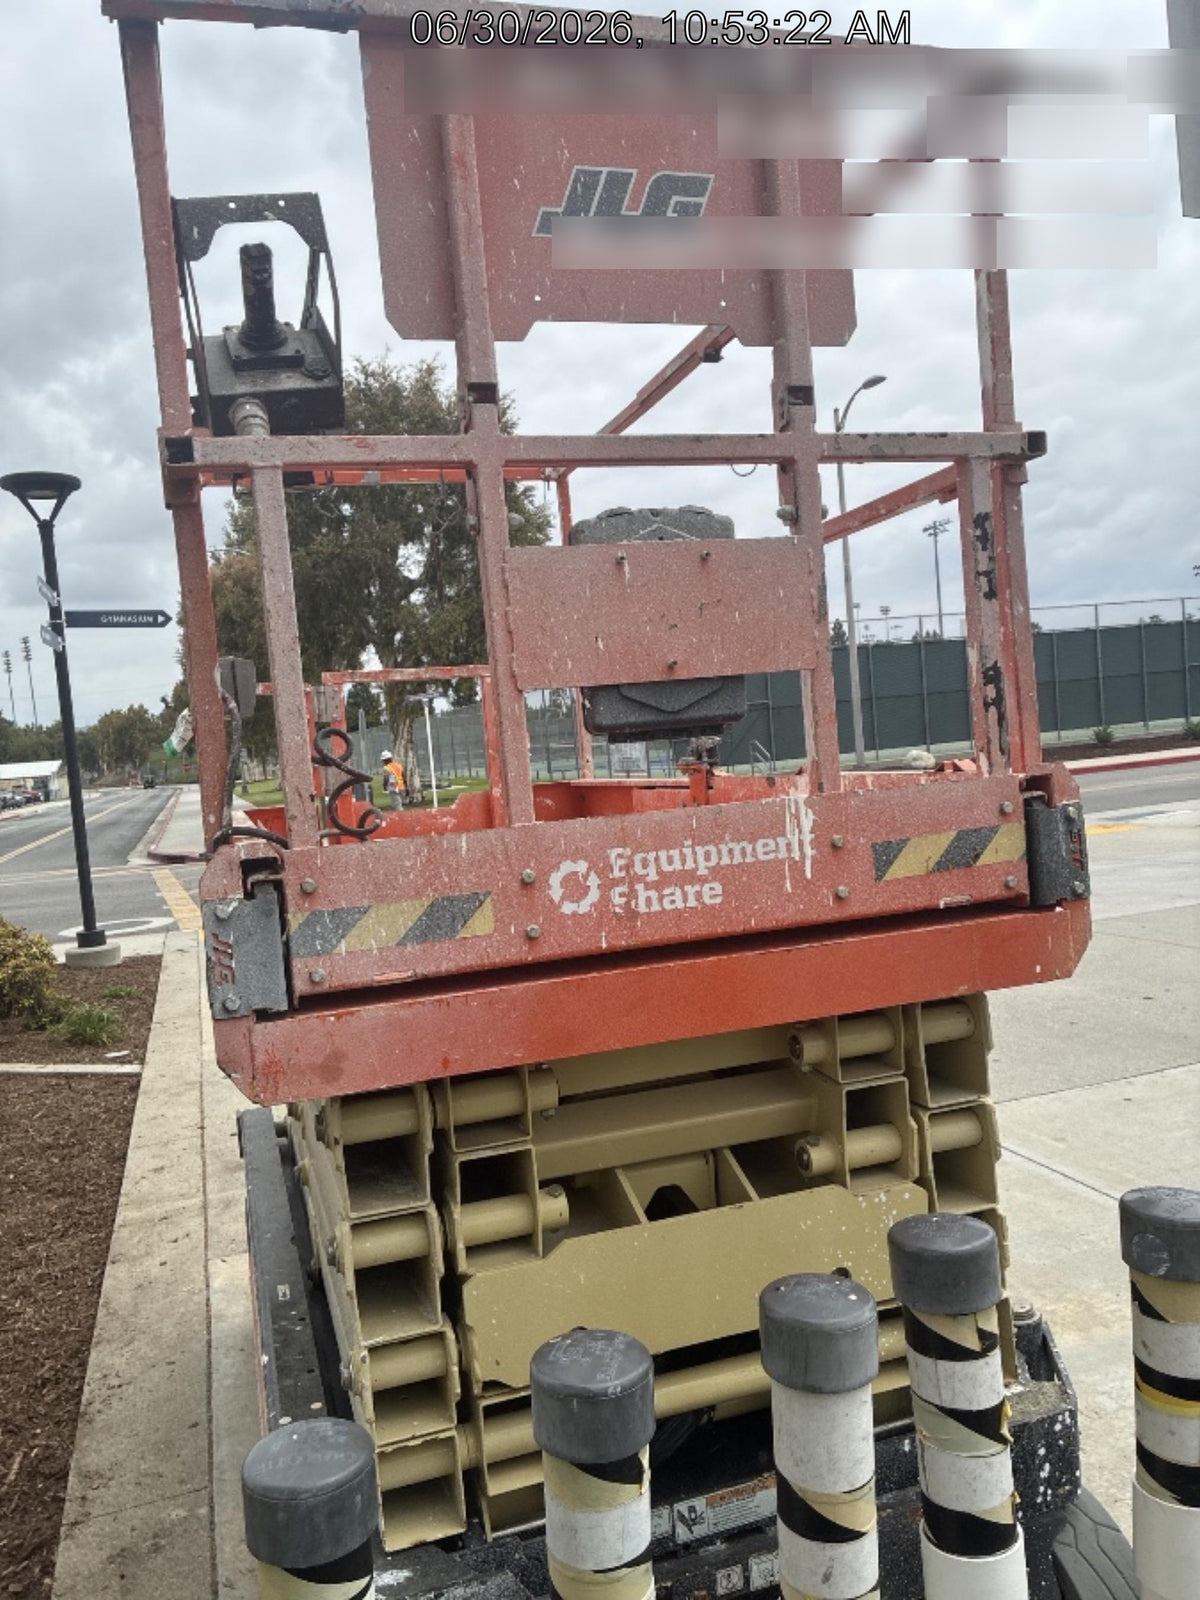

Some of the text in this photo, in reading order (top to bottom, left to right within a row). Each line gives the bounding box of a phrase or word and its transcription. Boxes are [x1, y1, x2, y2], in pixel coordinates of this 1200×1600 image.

[532, 164, 715, 238] JLG
[100, 614, 154, 624] GYMNASIUM
[607, 830, 815, 881] Equipment
